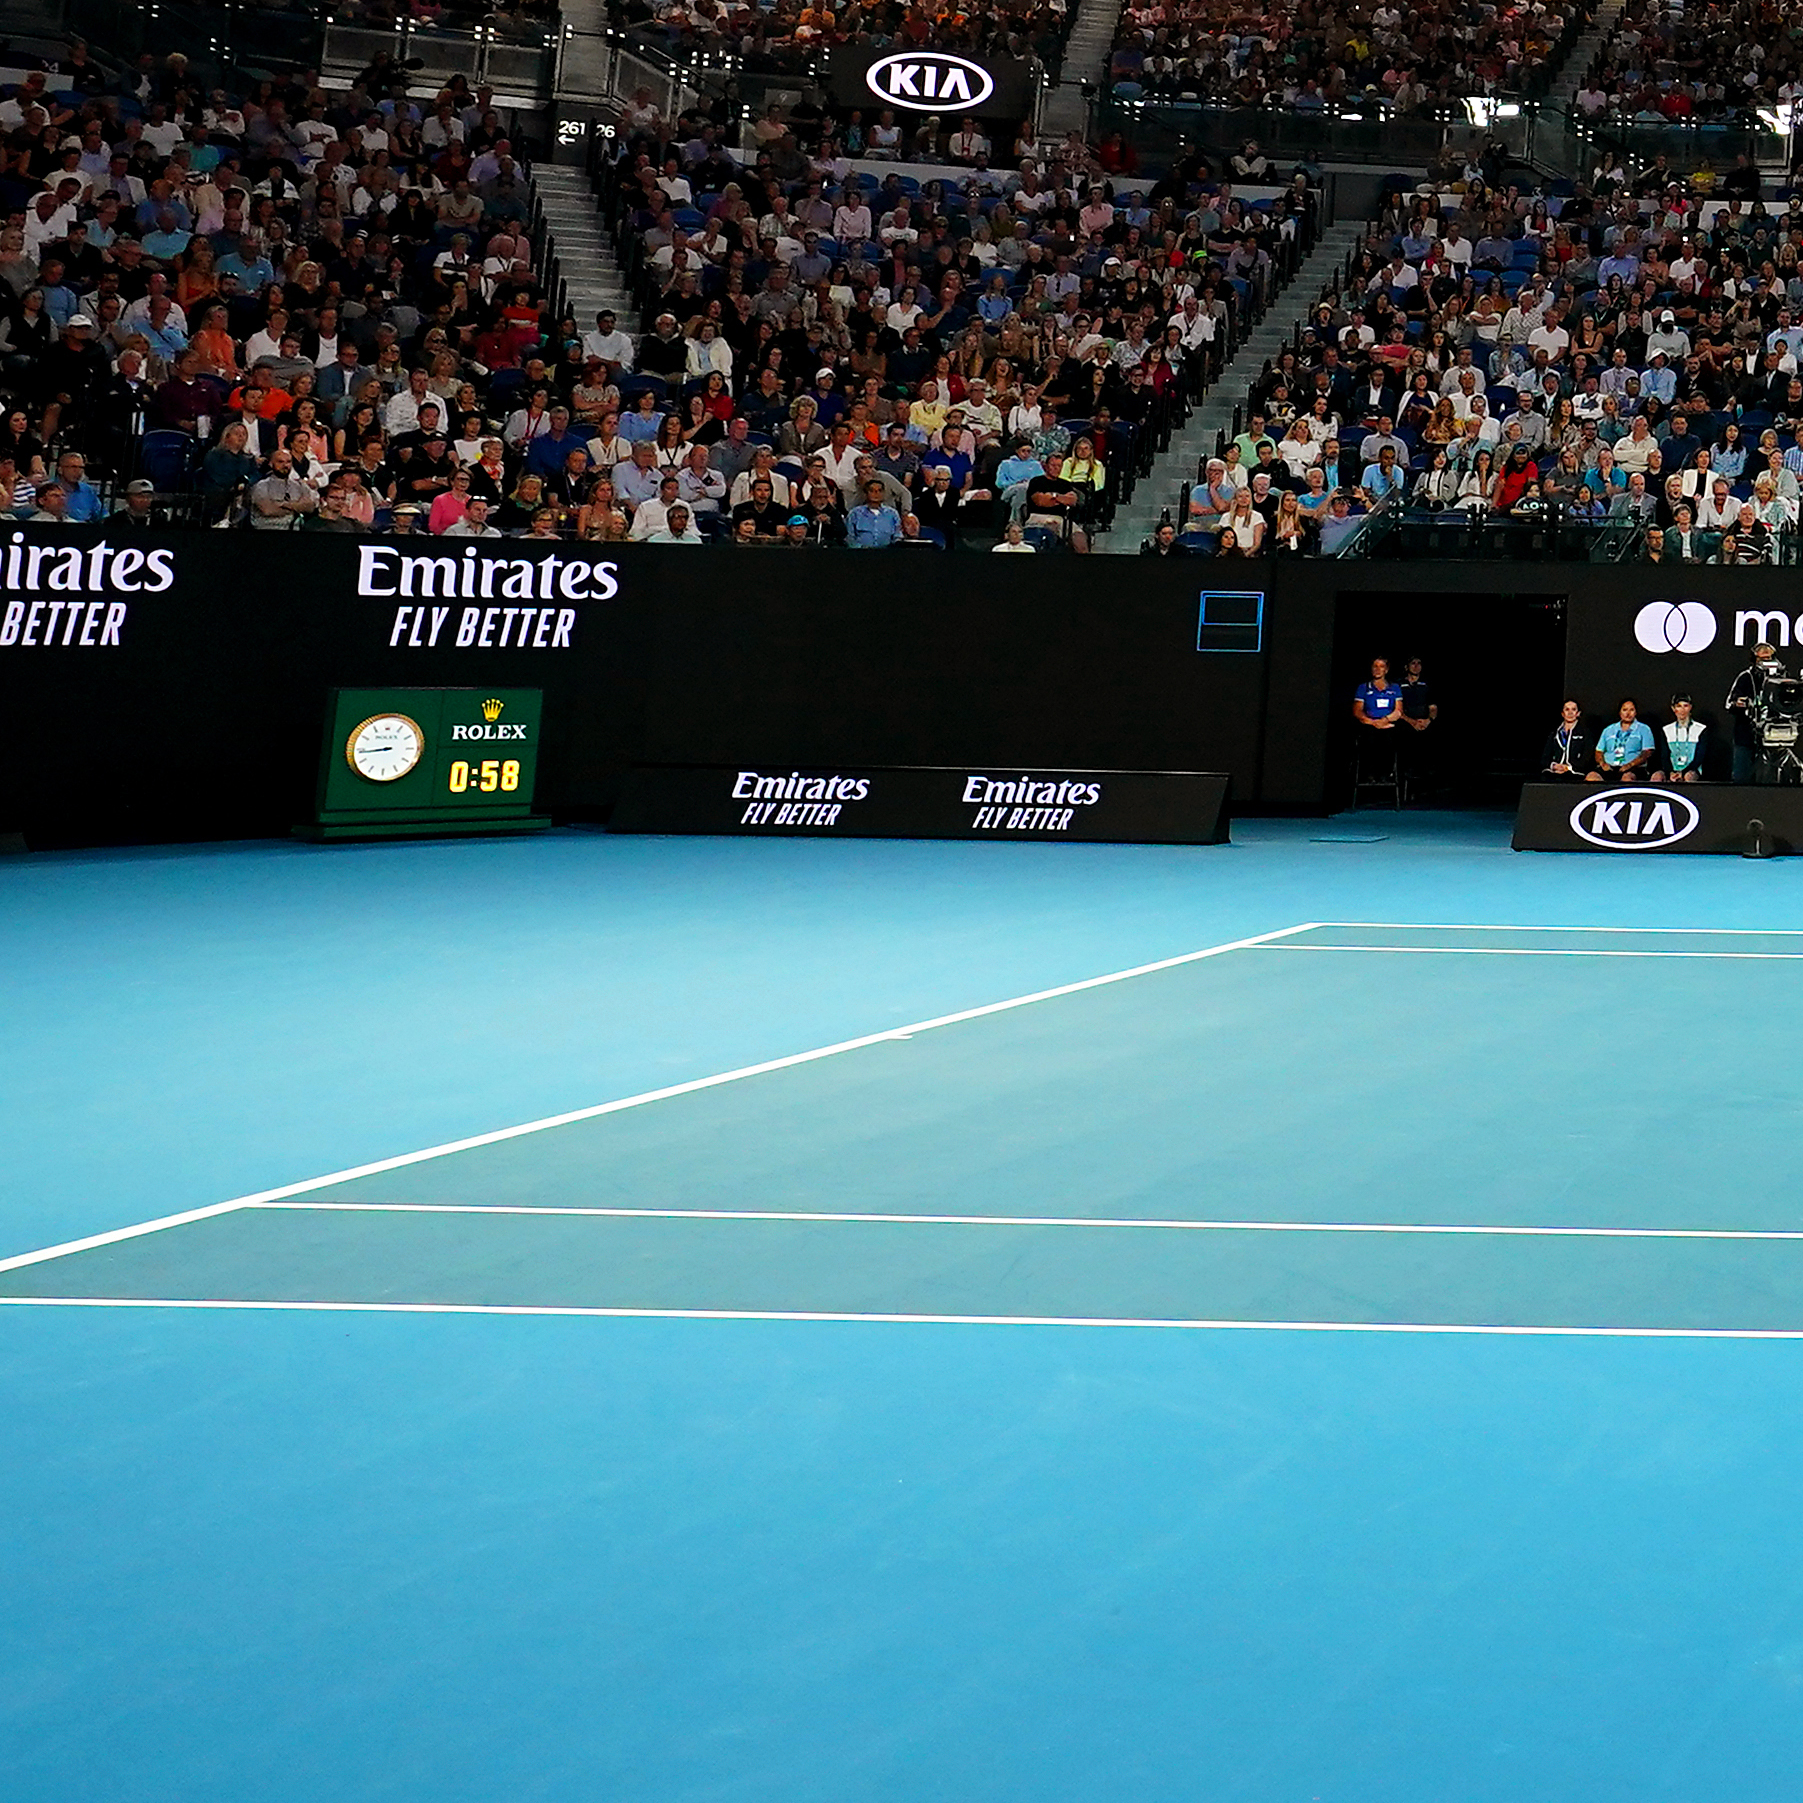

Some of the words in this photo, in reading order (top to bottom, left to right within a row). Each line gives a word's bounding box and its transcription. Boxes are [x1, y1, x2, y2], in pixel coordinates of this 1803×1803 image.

[889, 66, 970, 99] KIA
[558, 120, 586, 136] 261
[595, 123, 616, 139] 26
[0, 532, 174, 592] irates
[357, 545, 618, 600] Emirates
[0, 601, 127, 646] BETTER
[389, 607, 449, 647] FLY
[456, 608, 576, 648] BETTER
[452, 725, 527, 740] ROLEX
[449, 759, 520, 792] 0:58
[731, 771, 871, 801] Emirates
[962, 775, 1101, 805] Emirates
[740, 802, 777, 825] FLY
[773, 803, 843, 826] BETTER
[972, 806, 1008, 829] FLY
[1005, 807, 1074, 830] BETTER
[1592, 800, 1676, 835] KIA
